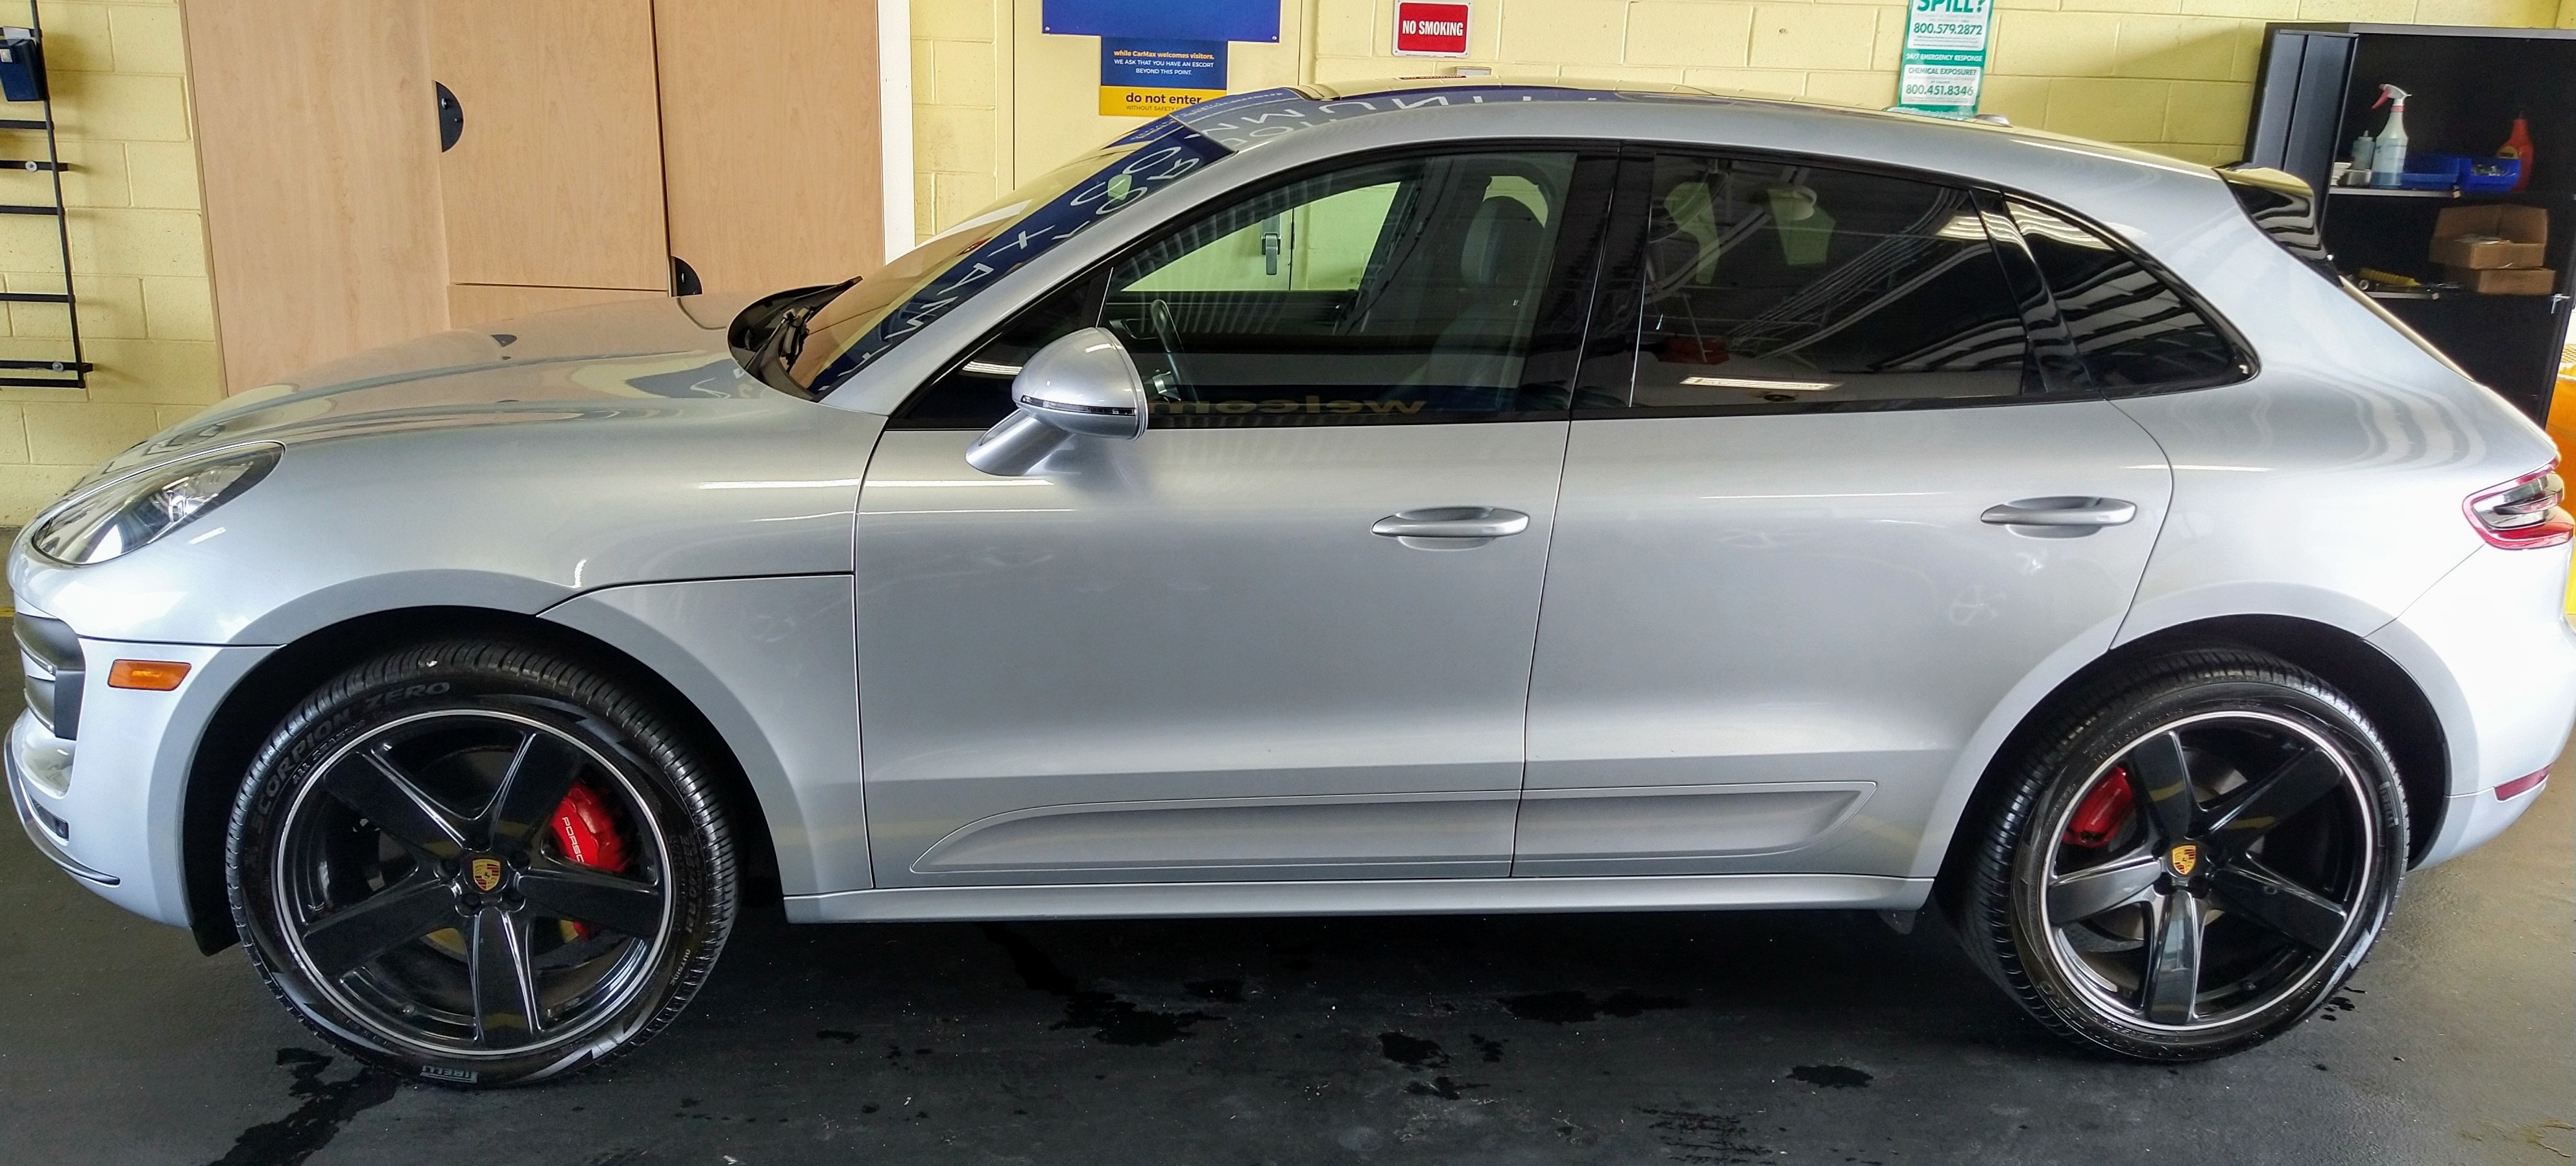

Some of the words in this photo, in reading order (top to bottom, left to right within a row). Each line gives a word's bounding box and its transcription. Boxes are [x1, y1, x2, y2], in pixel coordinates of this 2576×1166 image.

[1402, 20, 1416, 34] NO
[1419, 21, 1463, 36] SMOKING
[1913, 23, 1982, 35] 800.579.2872
[1126, 92, 1142, 103] do
[1145, 94, 1166, 104] not
[1169, 95, 1202, 104] enter
[1905, 84, 1974, 96] 800.451.8346
[250, 706, 353, 834] SCORPION
[362, 681, 450, 714] ZERO
[561, 816, 584, 864] PORSC
[420, 1064, 479, 1084] PIRELLI
